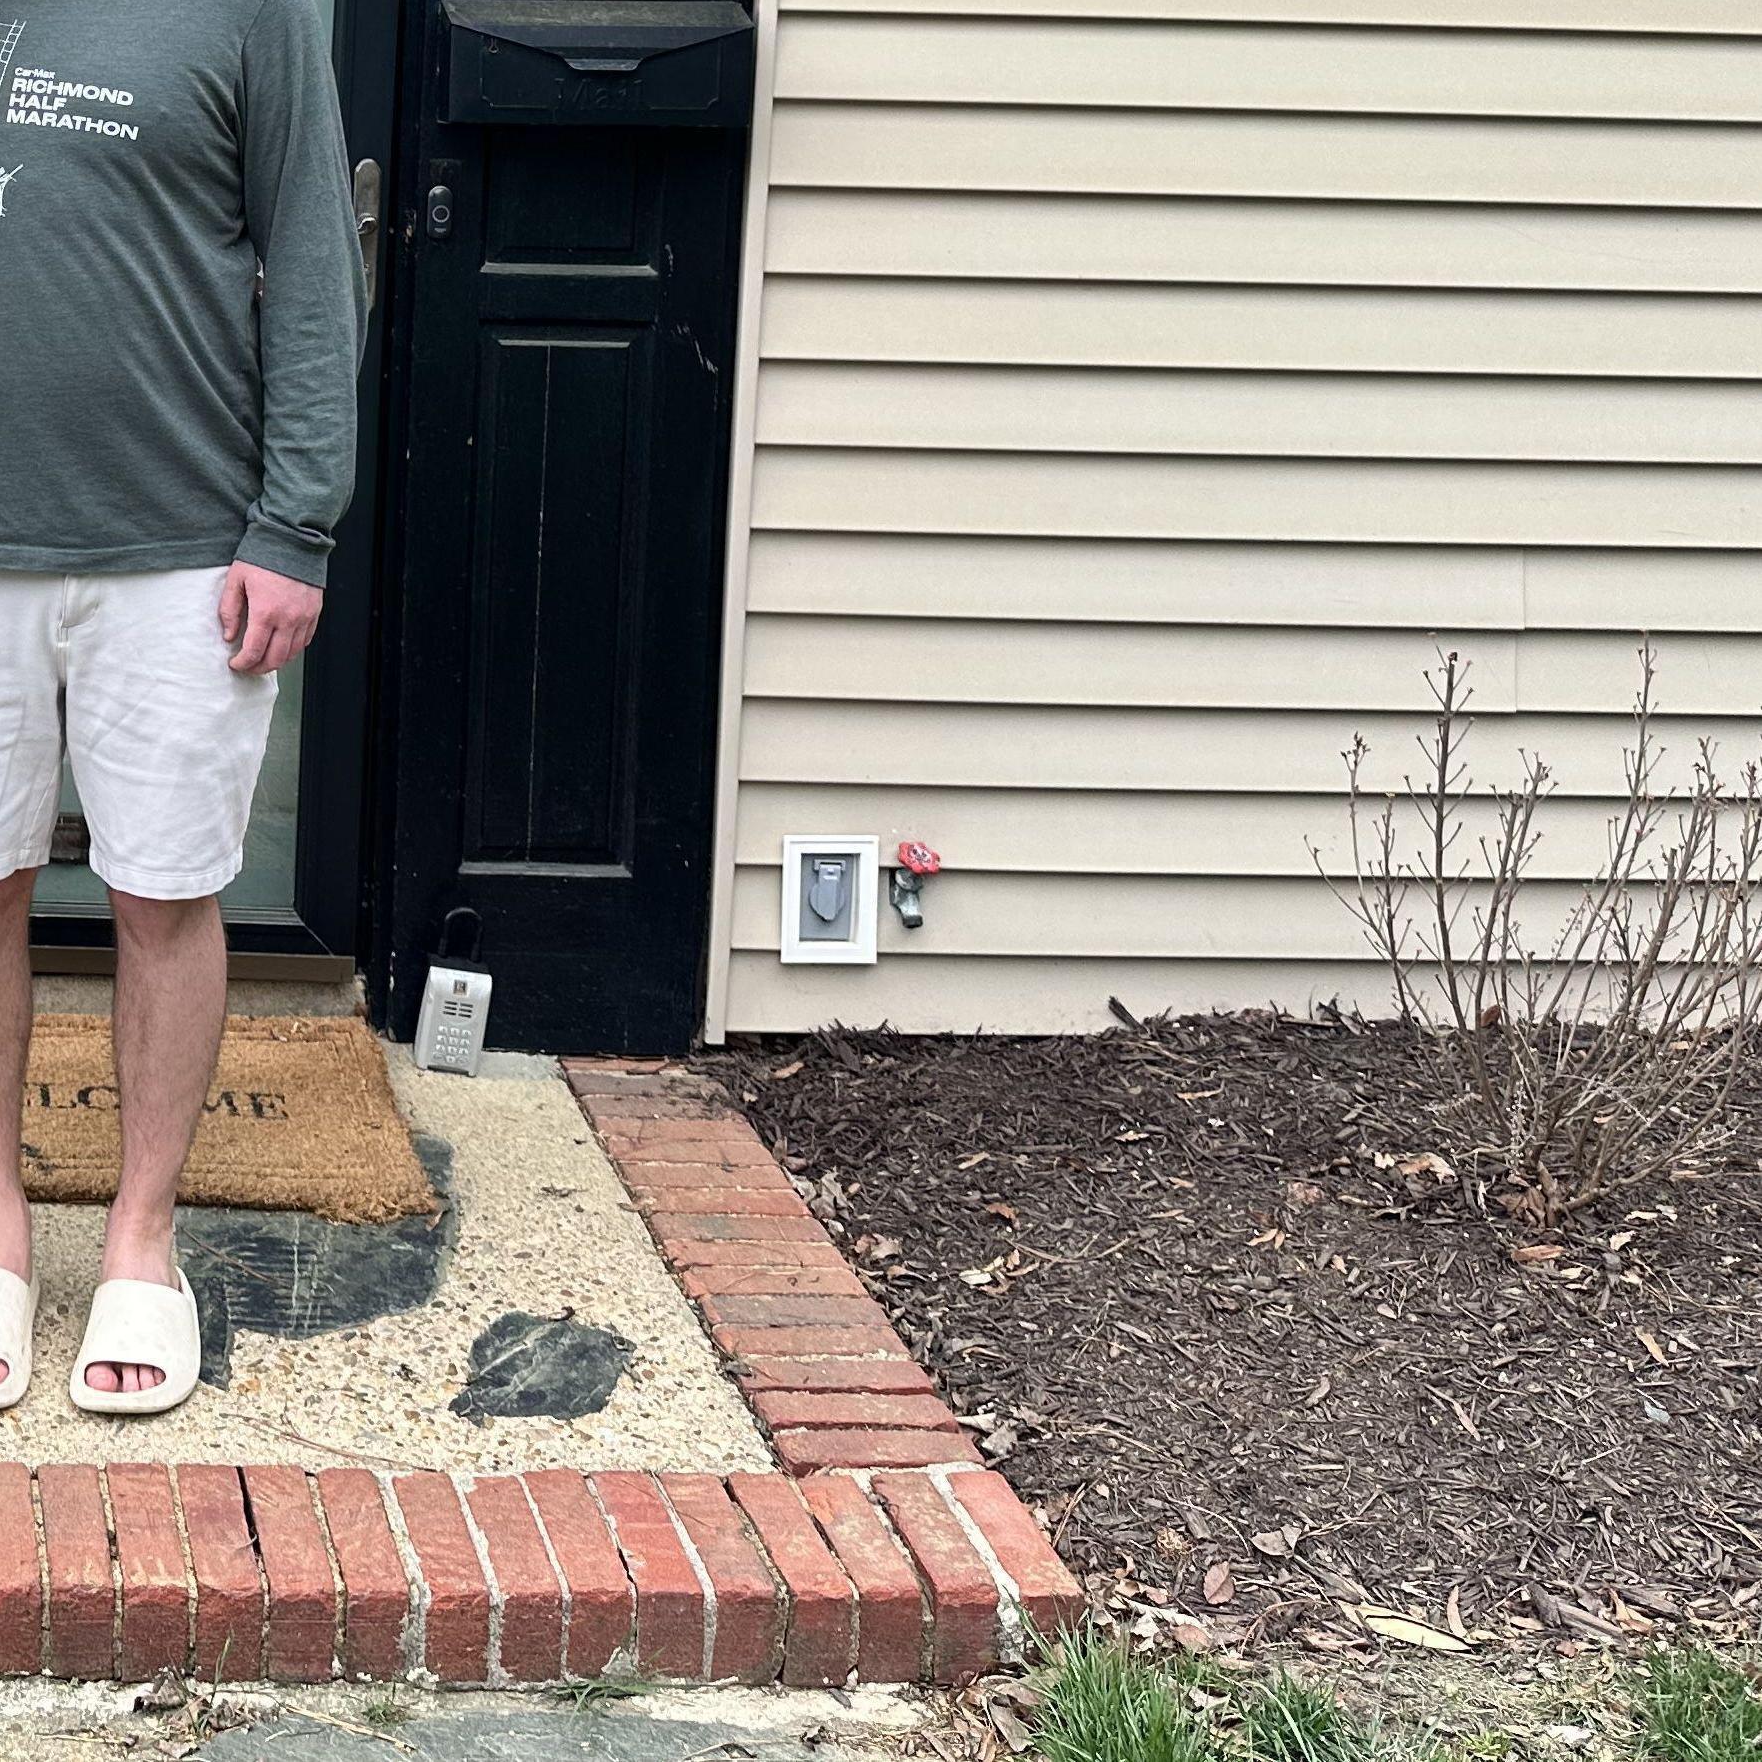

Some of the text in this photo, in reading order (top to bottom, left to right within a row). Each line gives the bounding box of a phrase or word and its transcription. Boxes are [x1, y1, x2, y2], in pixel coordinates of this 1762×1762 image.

[14, 67, 56, 79] CarMax
[8, 93, 67, 111] HALF
[11, 77, 134, 106] RICHMOND
[6, 108, 139, 141] MARATHON
